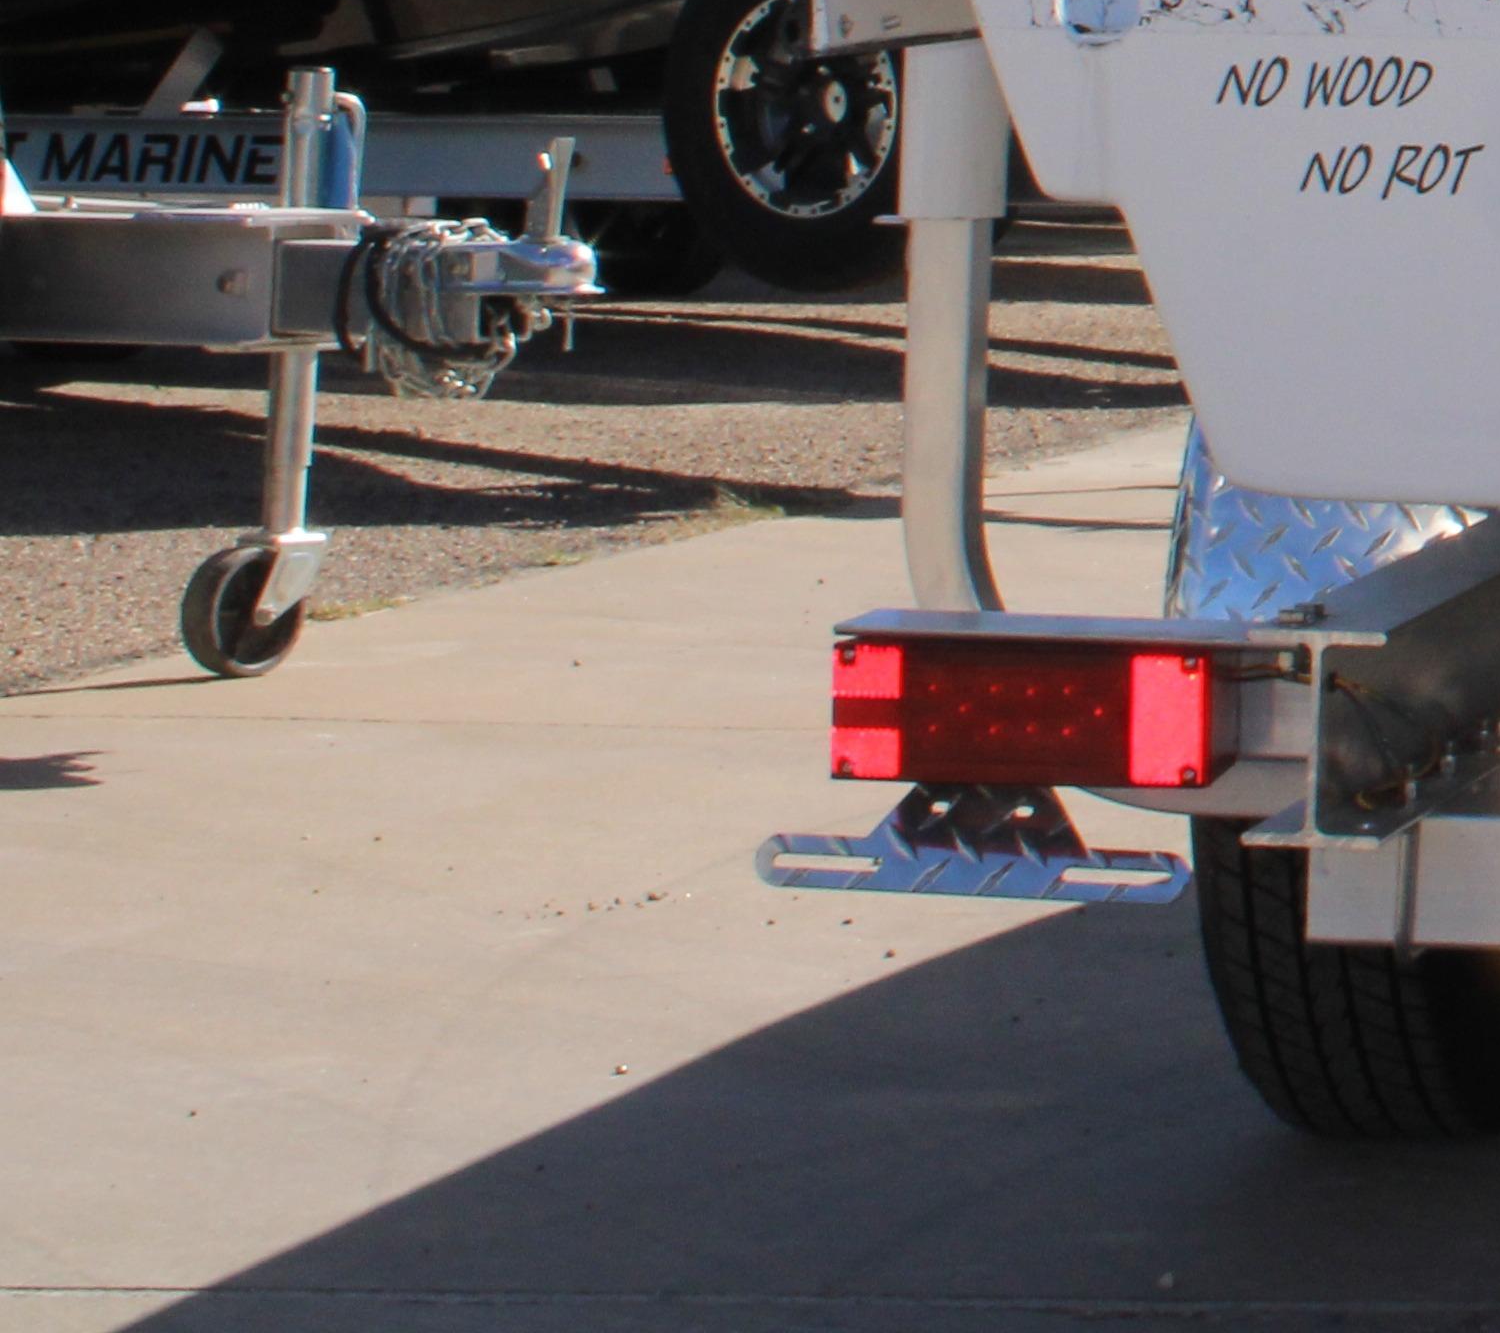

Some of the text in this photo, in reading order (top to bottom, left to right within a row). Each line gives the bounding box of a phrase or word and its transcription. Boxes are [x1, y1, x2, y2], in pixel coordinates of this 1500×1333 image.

[1216, 55, 1437, 109] NO WOOD
[40, 132, 285, 184] MARINE
[1300, 144, 1485, 201] NO ROT
